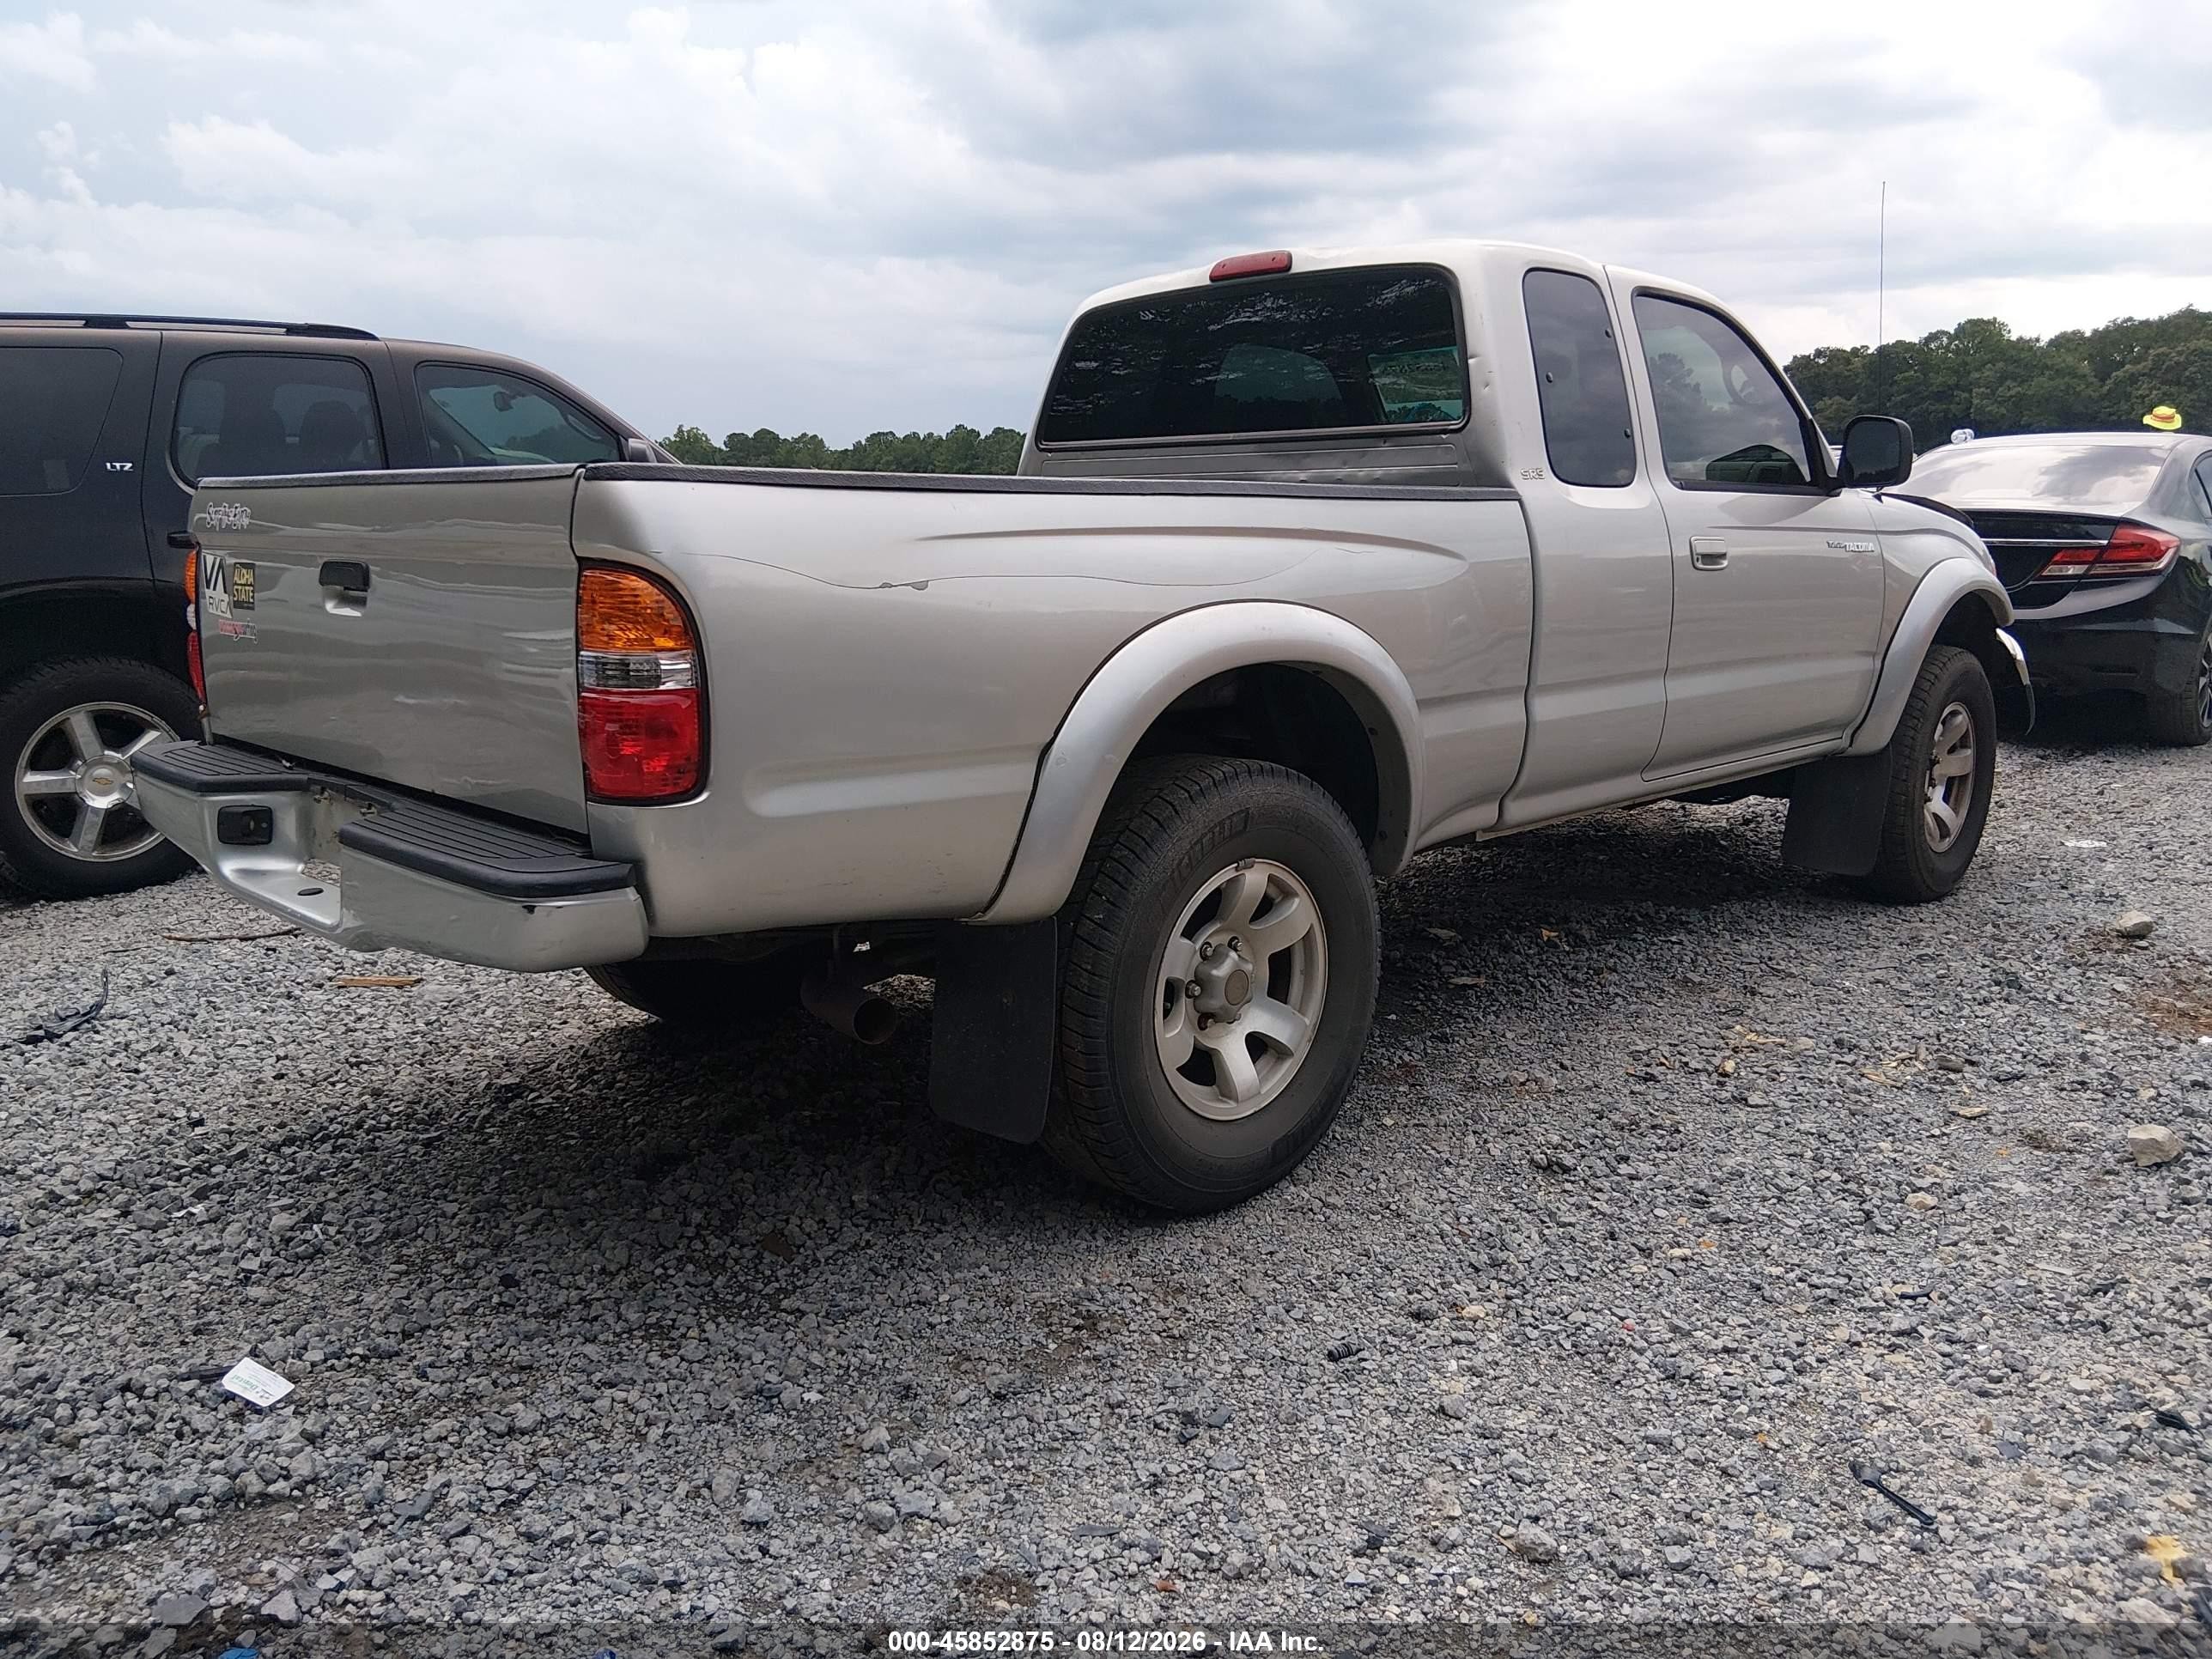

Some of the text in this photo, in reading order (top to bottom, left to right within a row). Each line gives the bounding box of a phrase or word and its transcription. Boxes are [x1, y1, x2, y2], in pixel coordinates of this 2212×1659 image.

[105, 462, 134, 471] LTZ
[233, 568, 254, 585] ALOHA
[233, 586, 254, 602] STATE
[208, 595, 232, 617] RVCA
